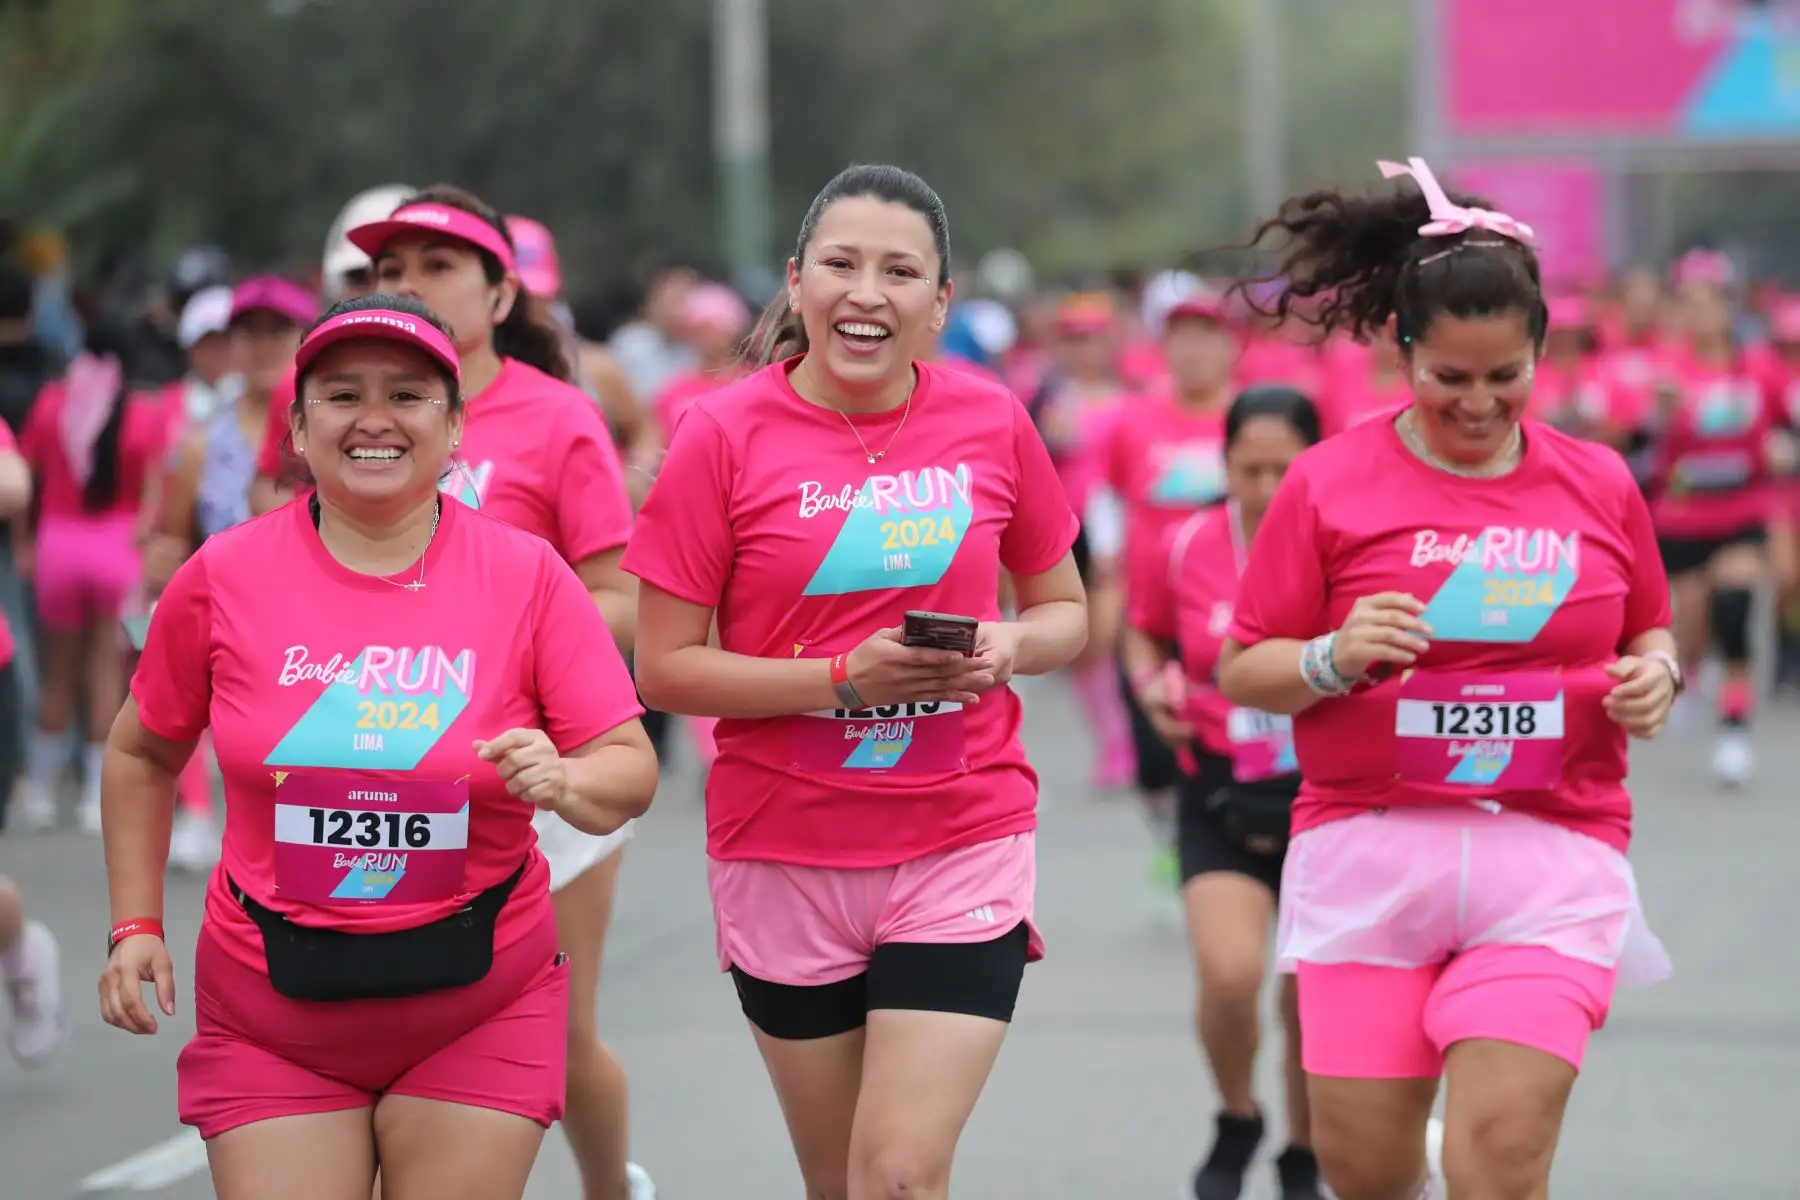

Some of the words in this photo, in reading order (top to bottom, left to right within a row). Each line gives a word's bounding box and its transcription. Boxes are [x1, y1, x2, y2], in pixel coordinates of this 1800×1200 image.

[798, 480, 873, 518] Barbie
[869, 463, 974, 515] RUN
[880, 516, 955, 550] 2024
[884, 553, 911, 571] LIMA
[1482, 526, 1582, 576] RUN
[1482, 578, 1553, 609] 2024
[278, 645, 361, 686] Barbie
[357, 645, 476, 698] RUN
[355, 700, 440, 731] 2024
[873, 720, 914, 741] RUN
[1432, 704, 1537, 736] 12318
[353, 733, 384, 752] LIMA
[347, 788, 398, 802] aruma
[309, 807, 431, 849] 12316
[363, 852, 408, 872] RUN
